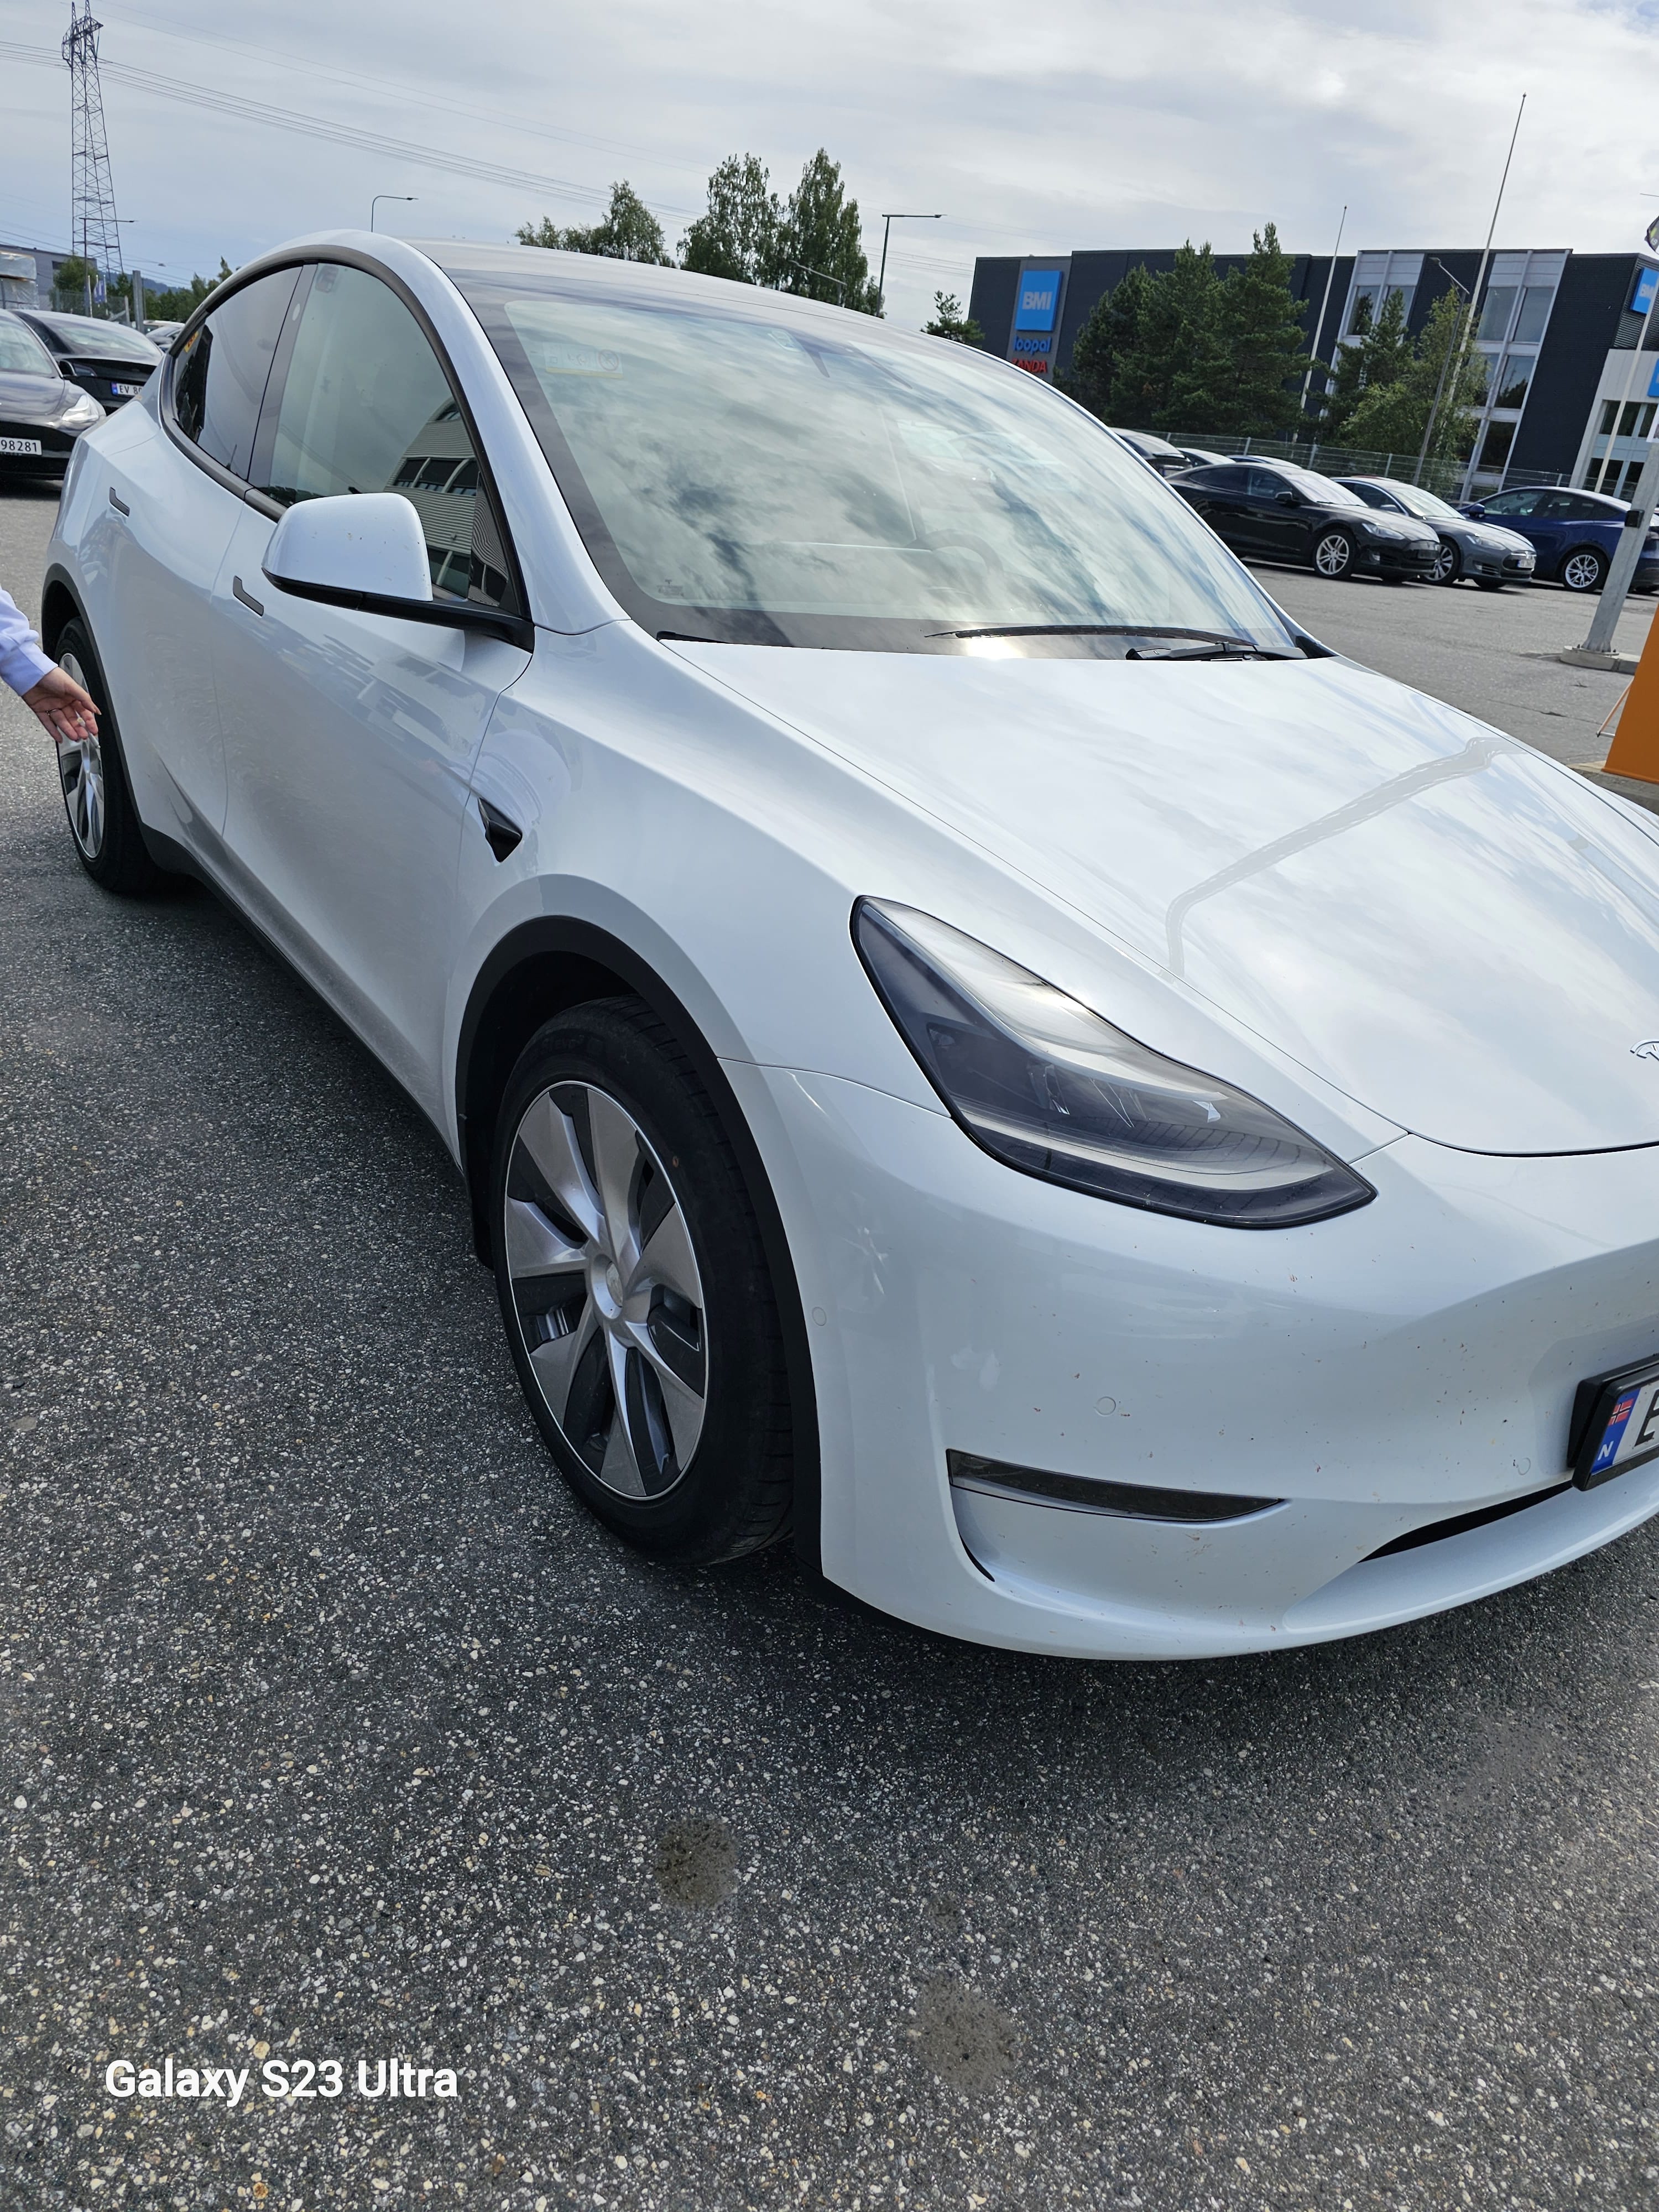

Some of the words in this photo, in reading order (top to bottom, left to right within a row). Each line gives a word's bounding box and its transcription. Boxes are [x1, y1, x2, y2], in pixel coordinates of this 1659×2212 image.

[1022, 291, 1053, 310] BMI
[119, 385, 129, 394] EV
[1, 439, 37, 452] 98281
[1597, 1440, 1614, 1460] N
